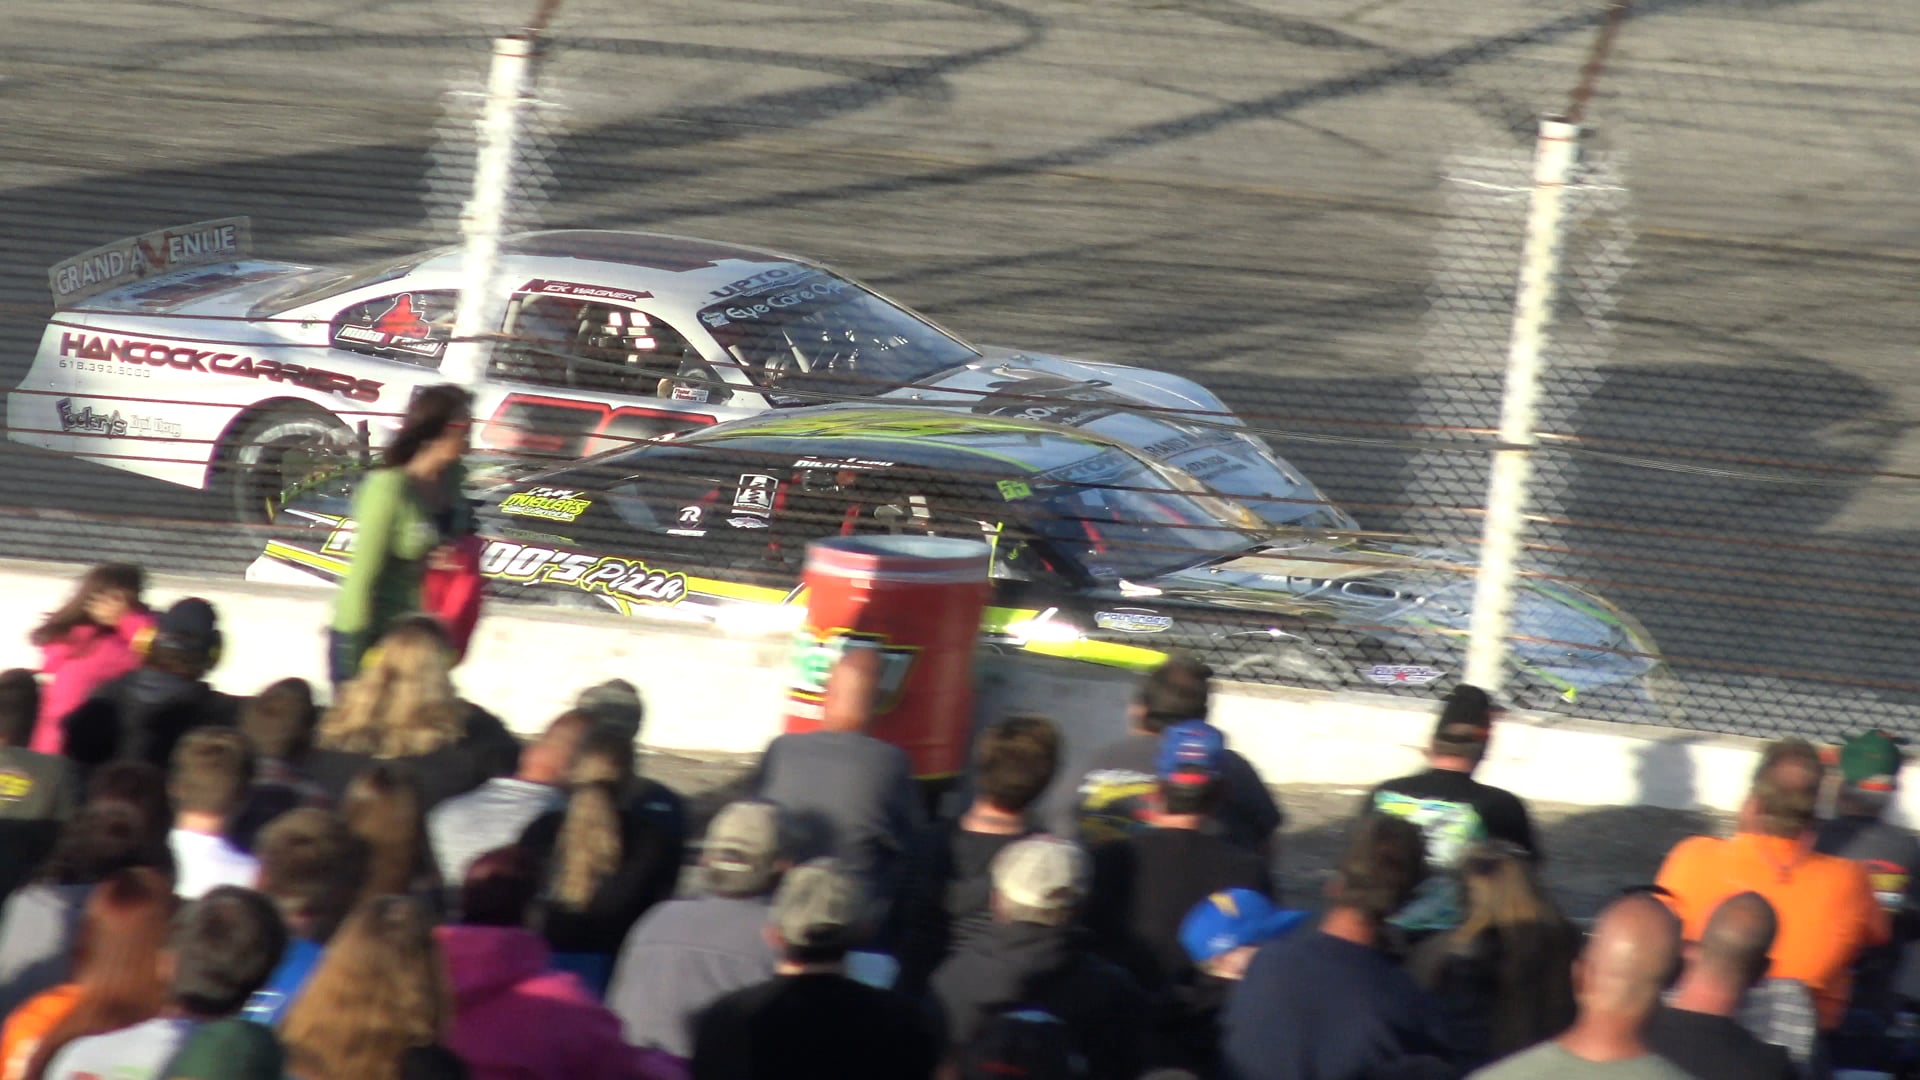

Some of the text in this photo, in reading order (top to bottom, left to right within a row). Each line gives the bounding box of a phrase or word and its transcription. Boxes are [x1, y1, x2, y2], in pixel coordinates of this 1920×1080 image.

[56, 225, 236, 295] GRAND AVENUE
[572, 287, 638, 300] WAGNER
[725, 303, 770, 319] Eye
[766, 287, 816, 308] Care
[60, 332, 217, 373] HANCOCK
[588, 563, 684, 599] Pizza
